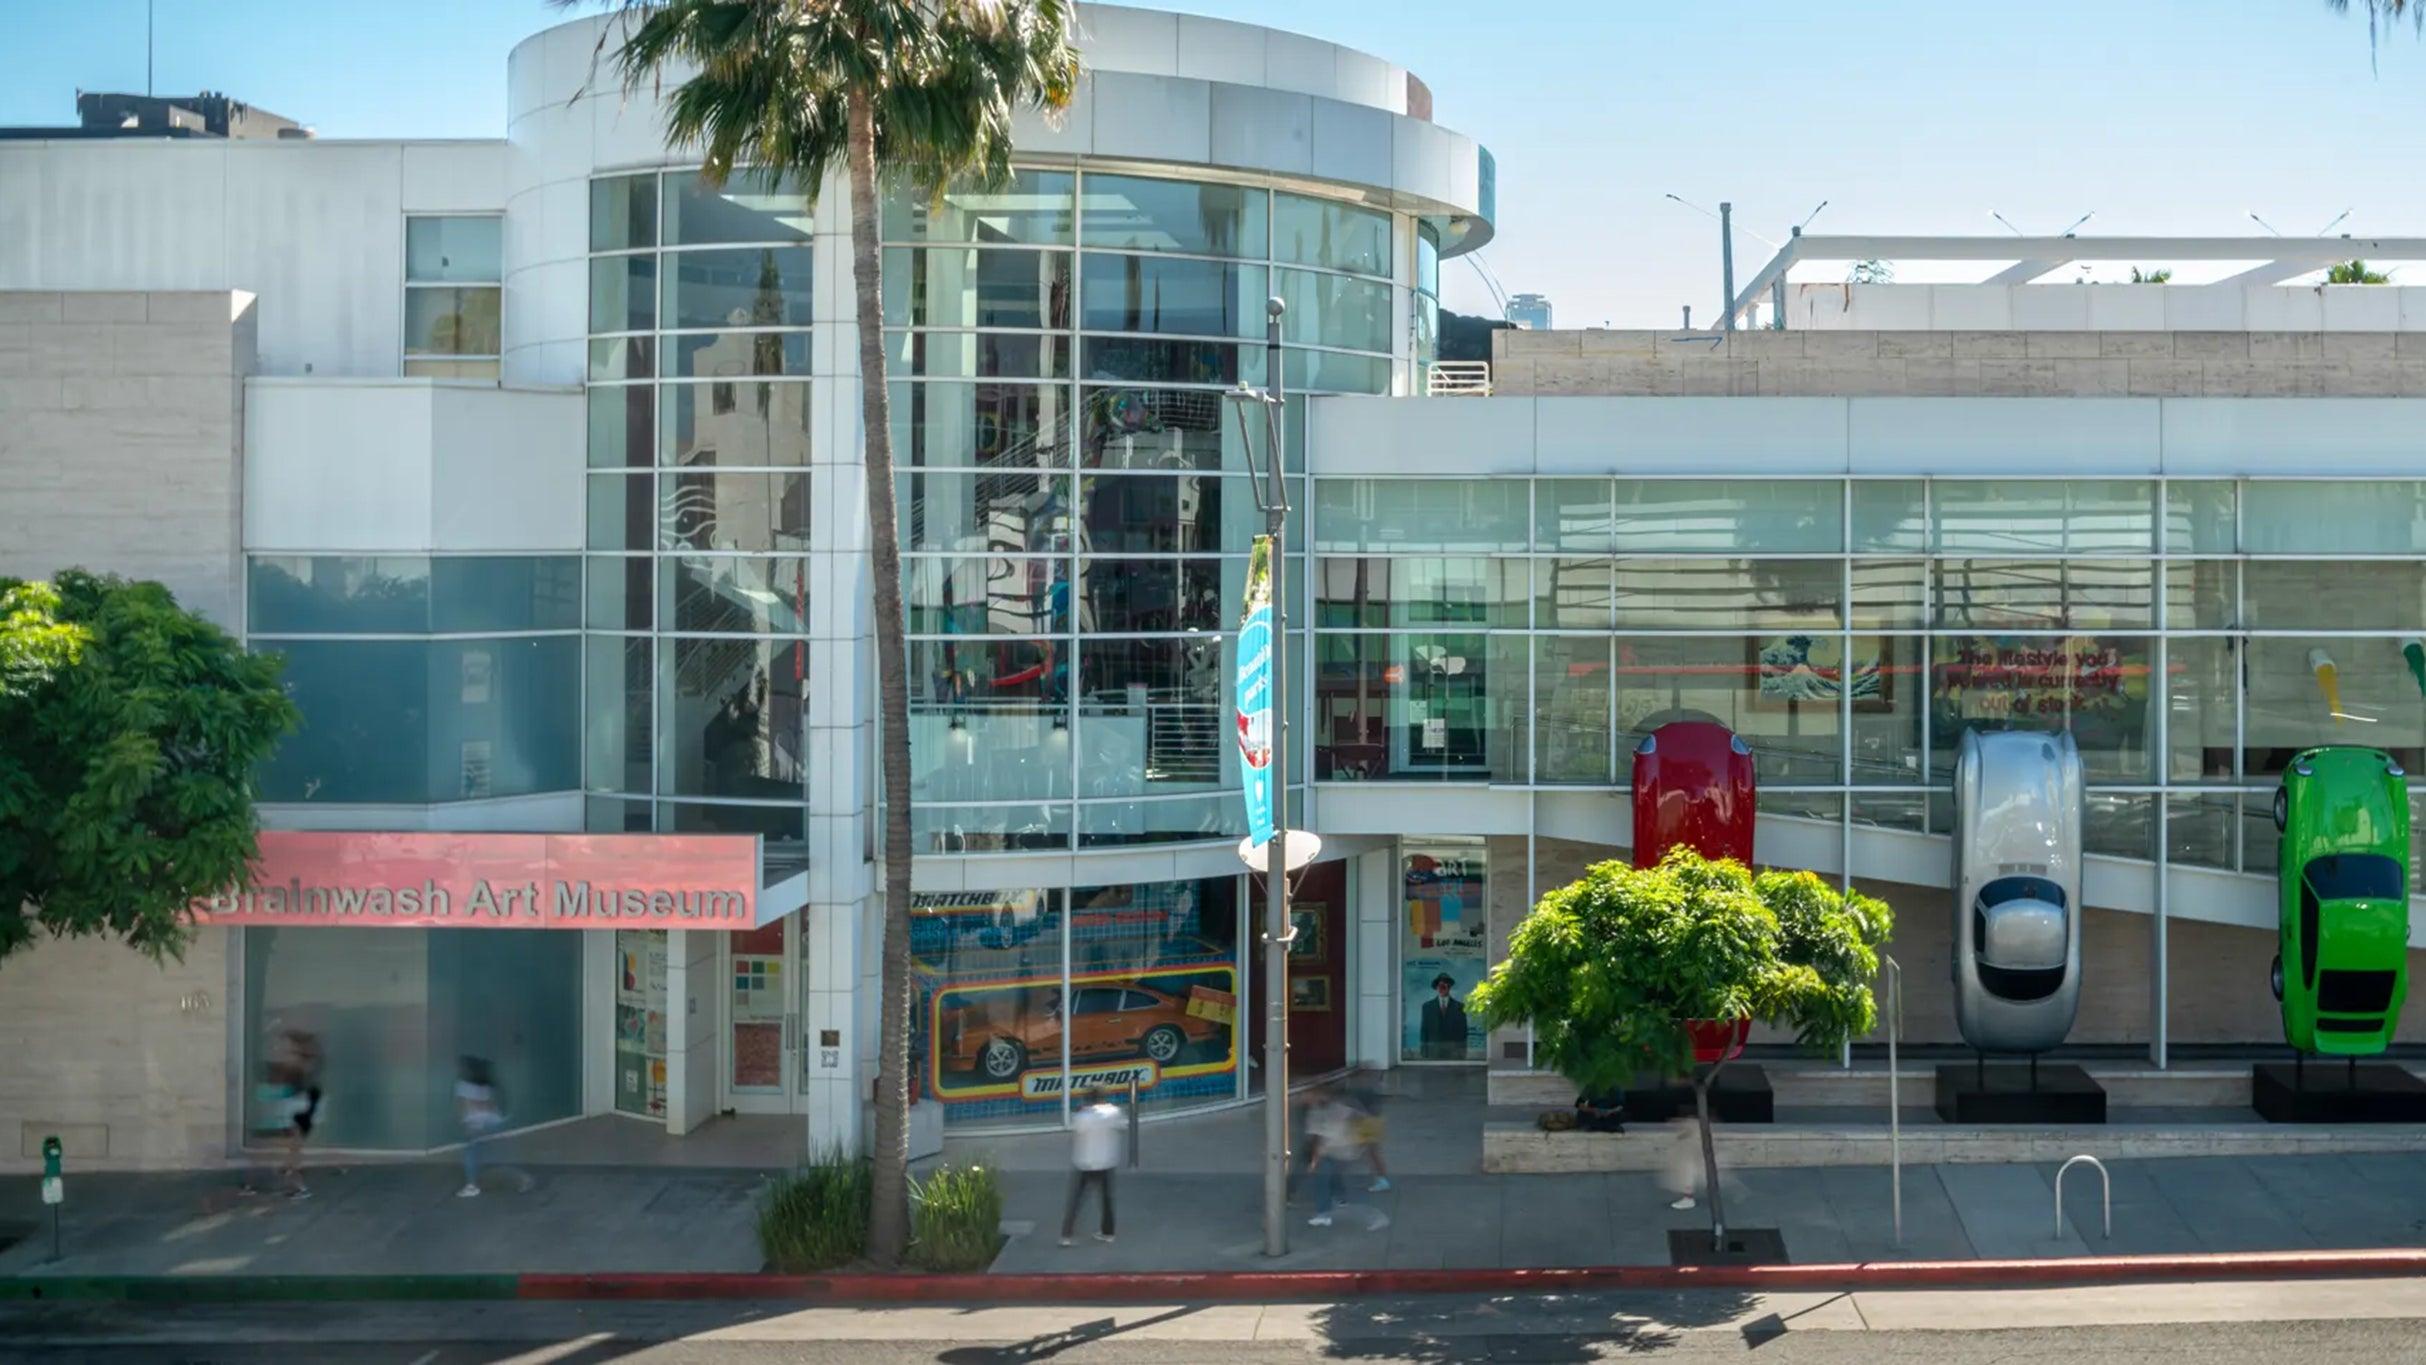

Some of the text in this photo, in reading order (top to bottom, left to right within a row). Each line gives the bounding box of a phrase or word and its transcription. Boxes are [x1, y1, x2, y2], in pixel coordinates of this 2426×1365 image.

[210, 878, 746, 919] Brainwash Art Museum
[1033, 1068, 1144, 1093] MATCHBOX
